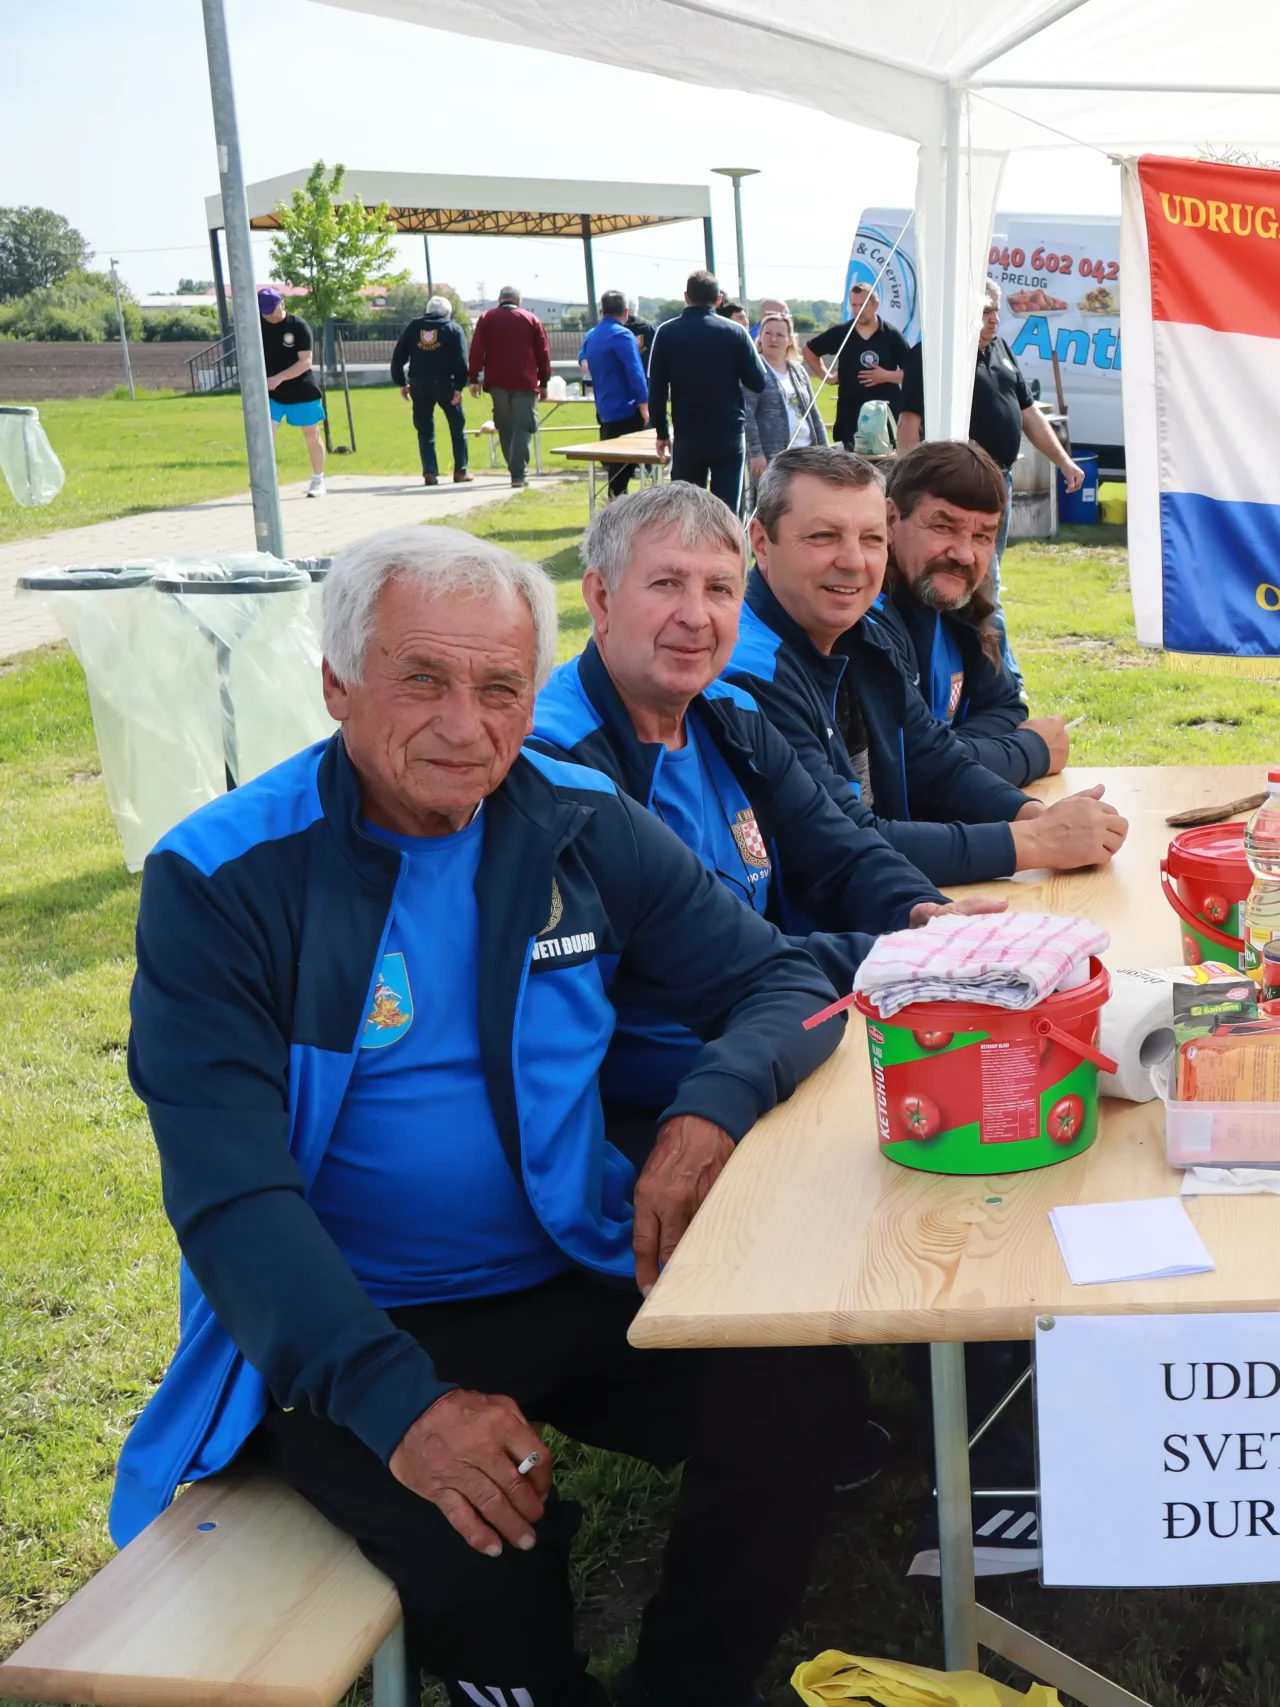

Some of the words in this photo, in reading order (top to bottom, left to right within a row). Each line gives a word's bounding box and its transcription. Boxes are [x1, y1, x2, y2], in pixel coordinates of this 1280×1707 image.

[988, 246, 1025, 271] 040
[1031, 247, 1073, 275] 602
[1078, 257, 1120, 284] 042
[1001, 272, 1048, 289] PRELOG
[873, 1056, 890, 1140] KETCHUP
